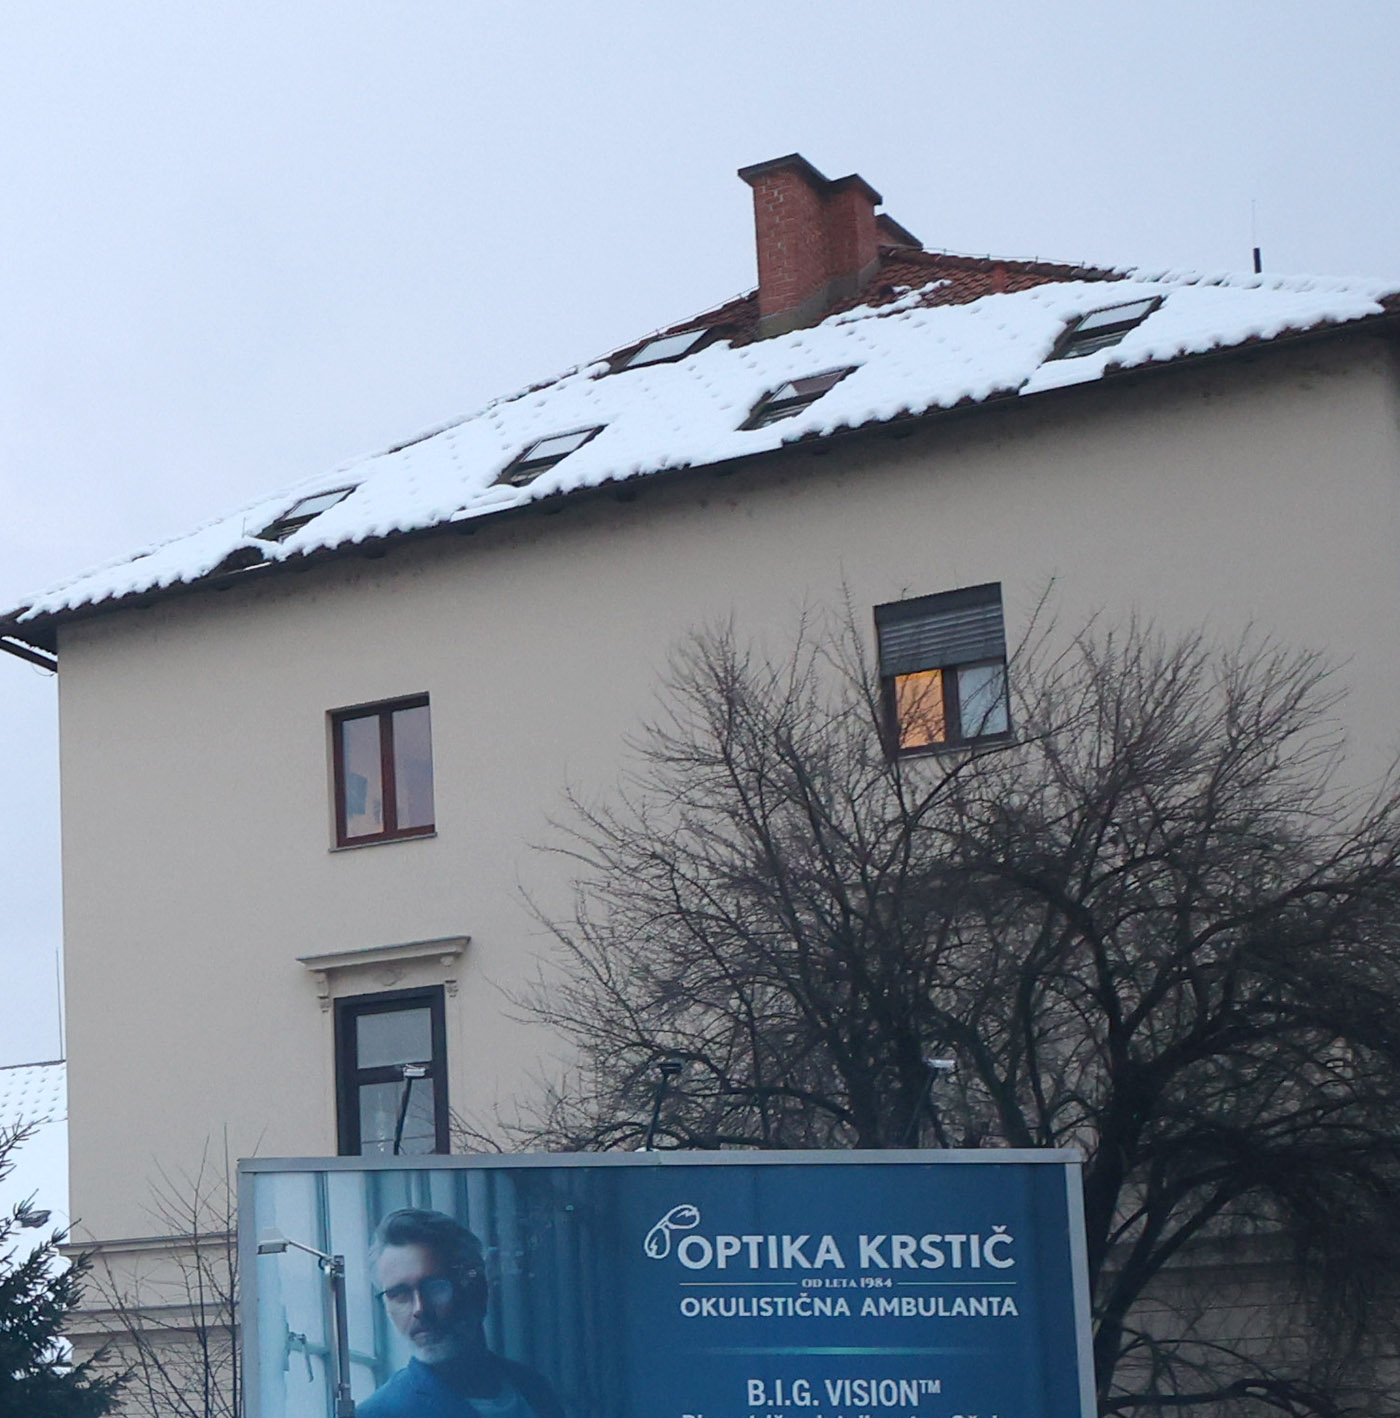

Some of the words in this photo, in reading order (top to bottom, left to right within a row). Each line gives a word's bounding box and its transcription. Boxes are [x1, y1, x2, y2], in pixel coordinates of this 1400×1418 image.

[677, 1234, 846, 1270] OPTIKA
[859, 1225, 1016, 1269] KRSTIČ
[801, 1278, 822, 1288] OD
[825, 1279, 857, 1288] LETA
[860, 1277, 892, 1289] 1984
[680, 1293, 850, 1317] OKULISTIČNA
[861, 1297, 1018, 1317] AMBULANTA
[747, 1379, 820, 1407] B.I.G.
